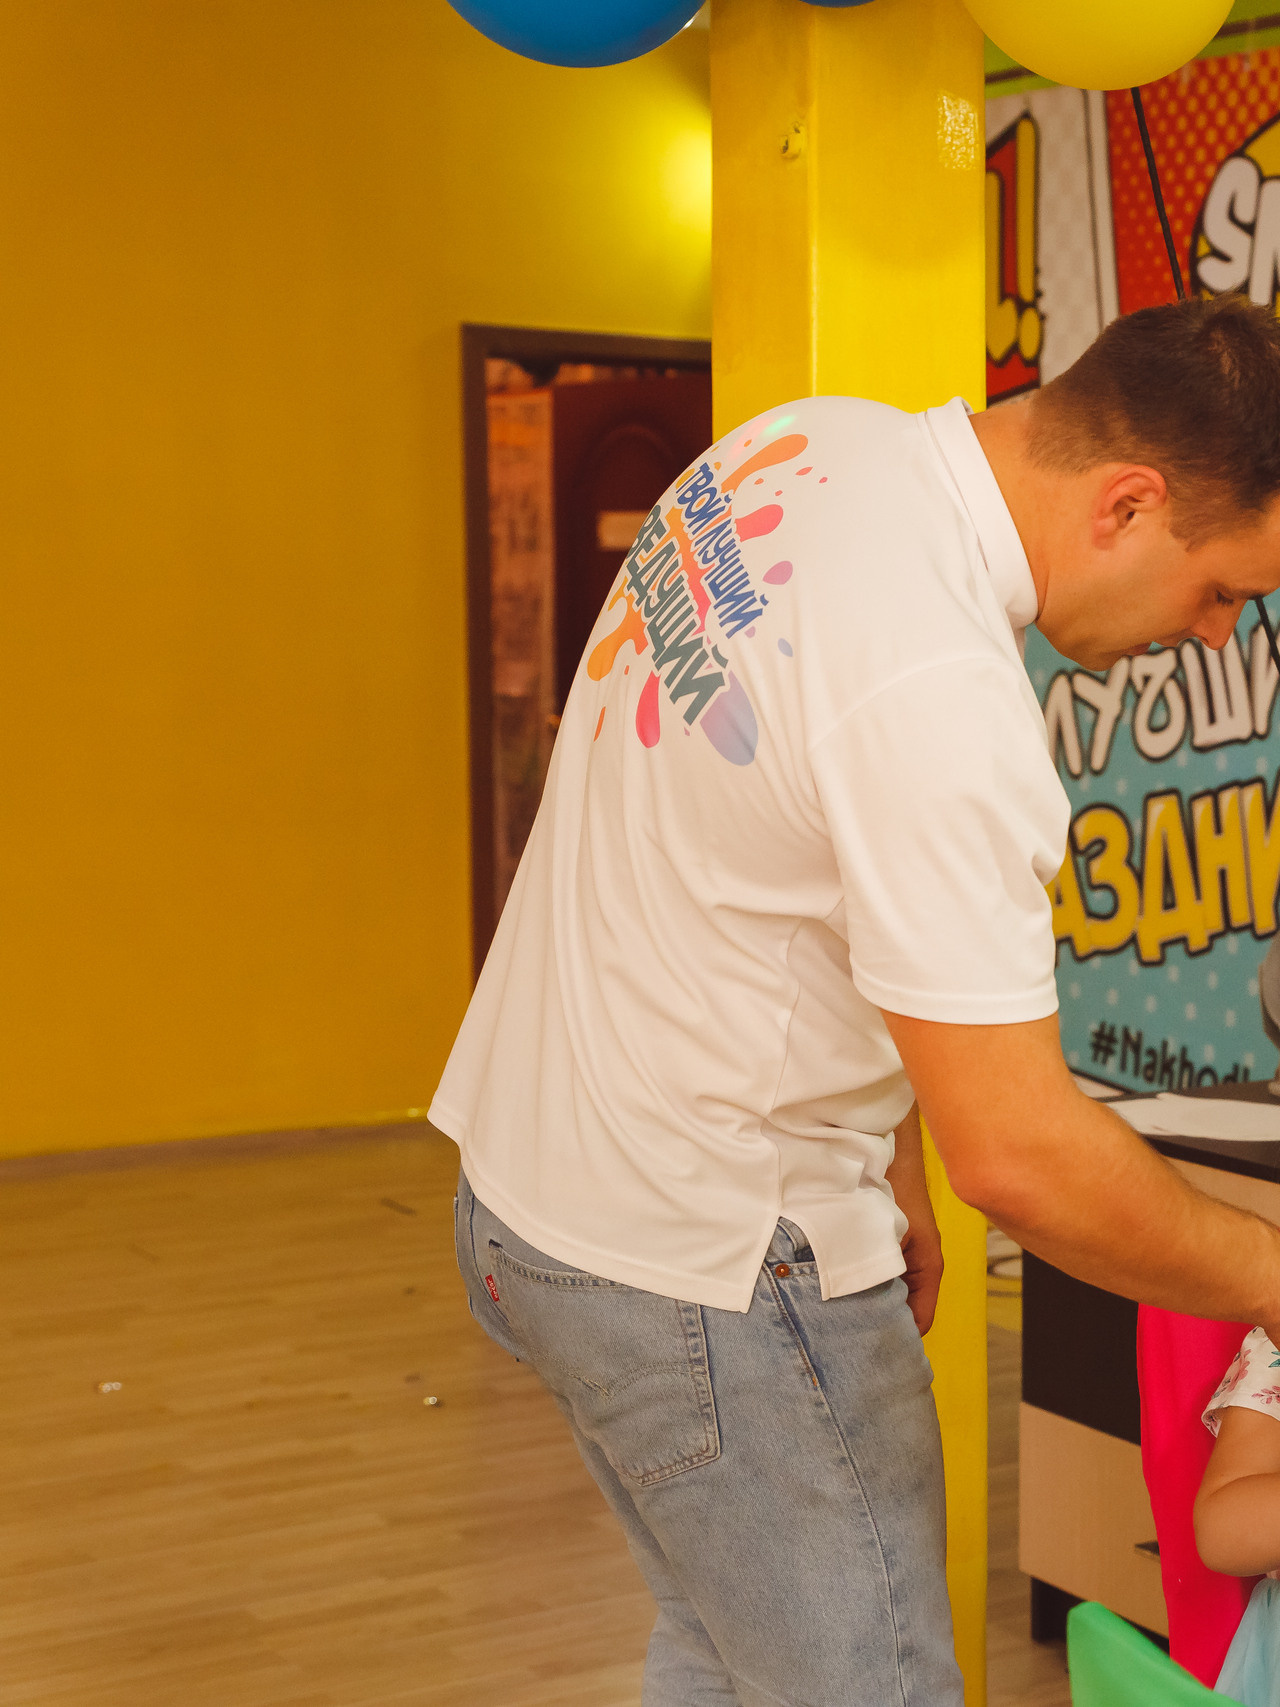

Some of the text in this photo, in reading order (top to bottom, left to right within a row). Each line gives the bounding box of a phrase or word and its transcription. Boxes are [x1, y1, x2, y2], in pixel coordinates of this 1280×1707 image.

[626, 504, 729, 726] ВЕДУЩИЙ
[675, 462, 770, 640] ТВОЙ ЛУЧШИЙ
